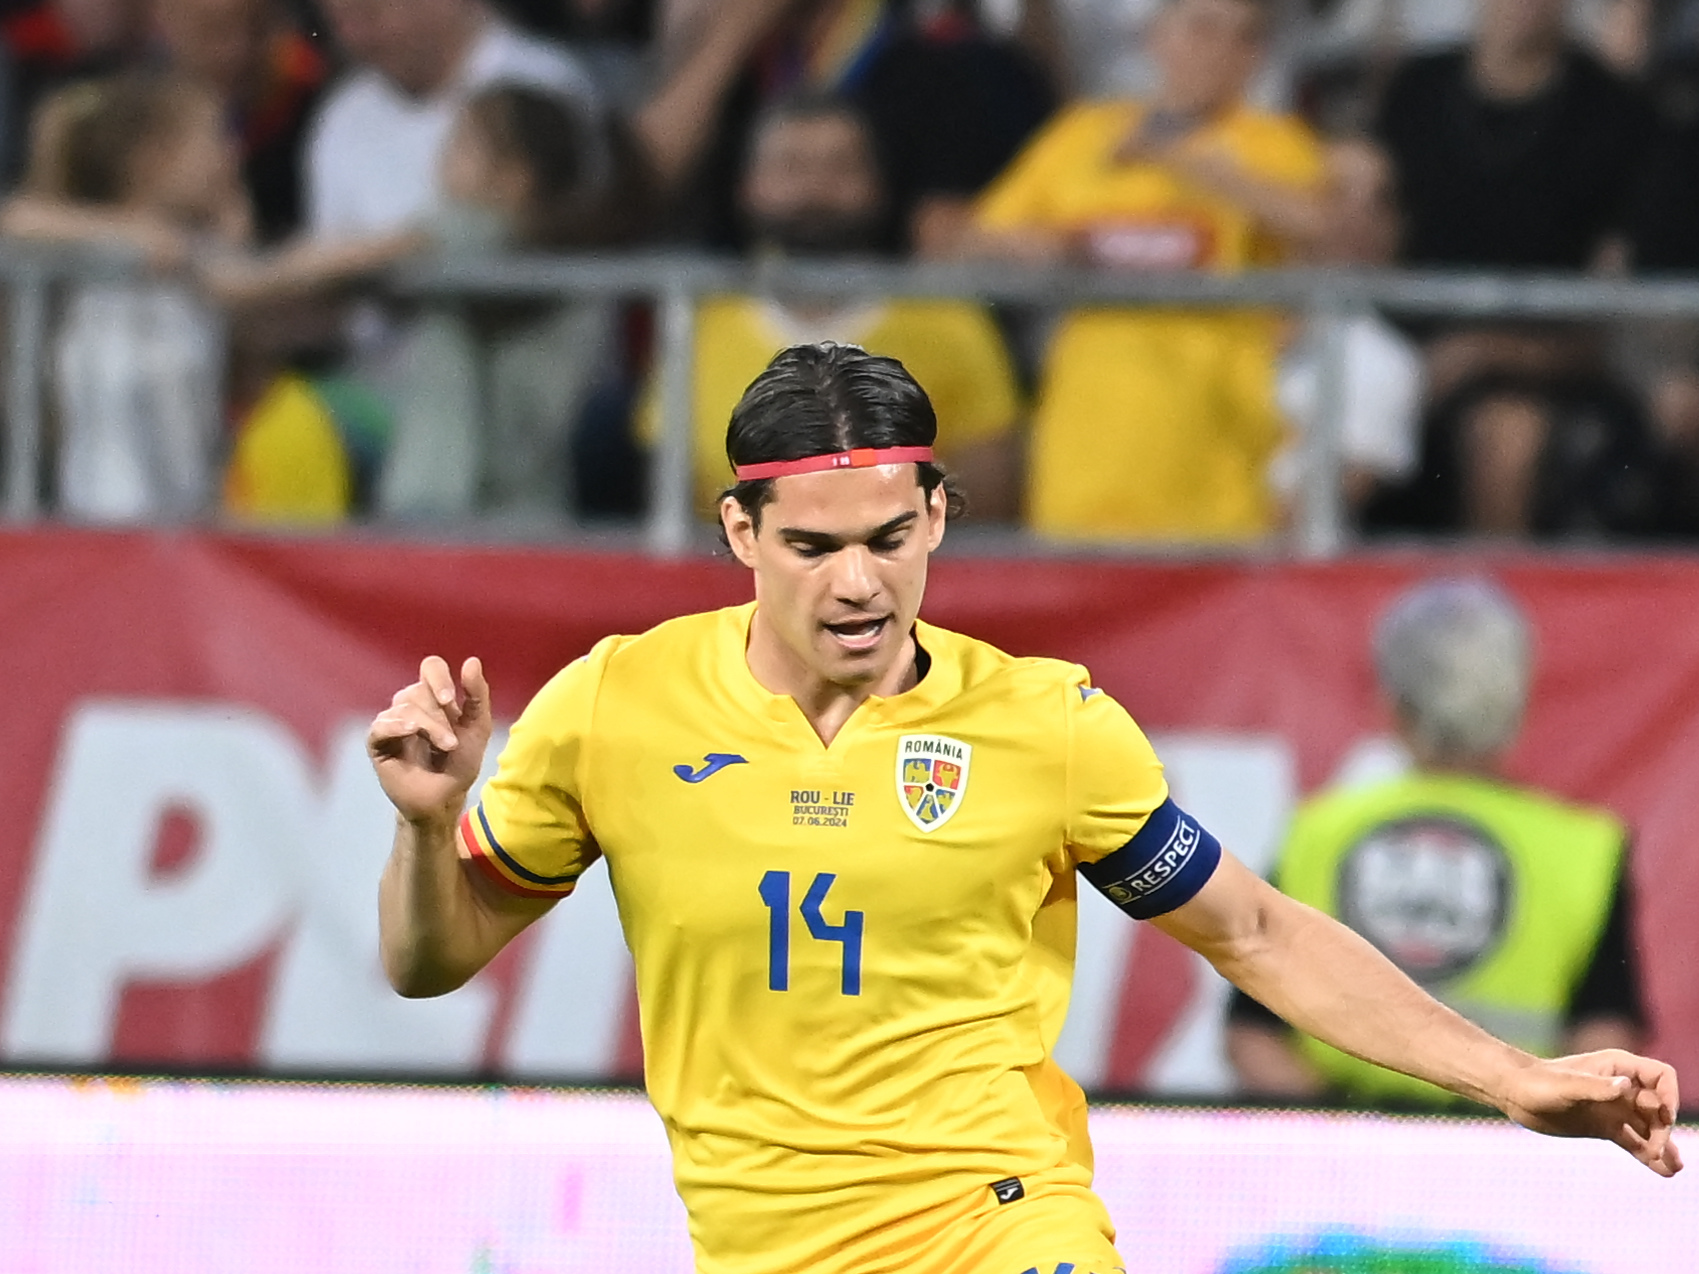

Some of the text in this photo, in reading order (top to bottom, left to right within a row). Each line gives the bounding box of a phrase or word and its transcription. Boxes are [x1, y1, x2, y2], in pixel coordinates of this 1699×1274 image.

[790, 790, 821, 804] ROU
[833, 791, 856, 806] LIE
[792, 816, 848, 828] 07.06.2024
[1130, 819, 1196, 892] RESPECT
[757, 870, 864, 996] 14
